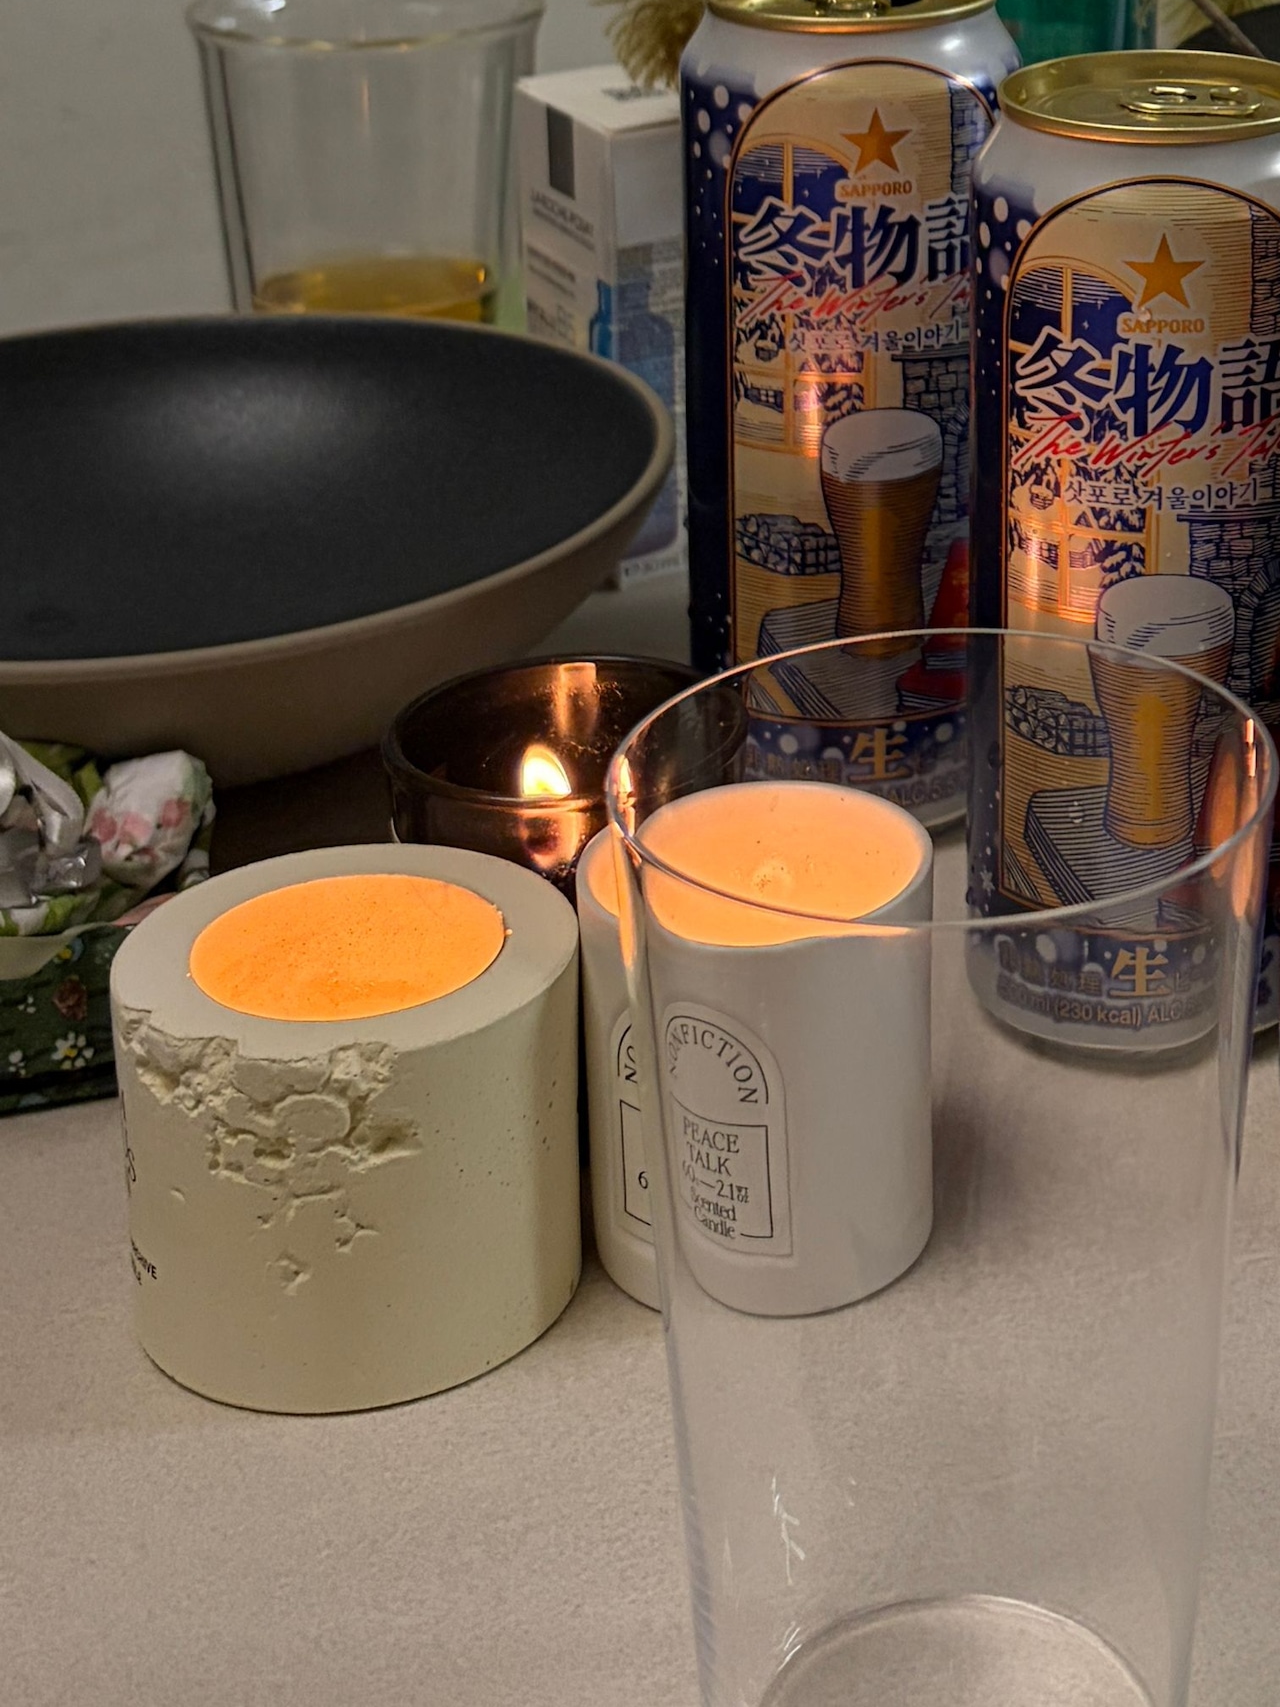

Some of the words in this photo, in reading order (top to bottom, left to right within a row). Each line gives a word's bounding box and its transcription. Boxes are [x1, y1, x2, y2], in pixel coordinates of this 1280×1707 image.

[839, 180, 913, 198] SAPPORO
[859, 319, 961, 353] 겨울이야기
[1121, 317, 1206, 334] SAPPORO
[1013, 412, 1087, 466] The
[1064, 480, 1134, 508] 삿포로
[1142, 478, 1260, 511] 겨울이야기
[1053, 999, 1094, 1023] (230
[1096, 1003, 1142, 1028] kcal)
[682, 1116, 741, 1154] PEACE
[686, 1140, 733, 1177] TALK
[694, 1206, 736, 1240] Candle
